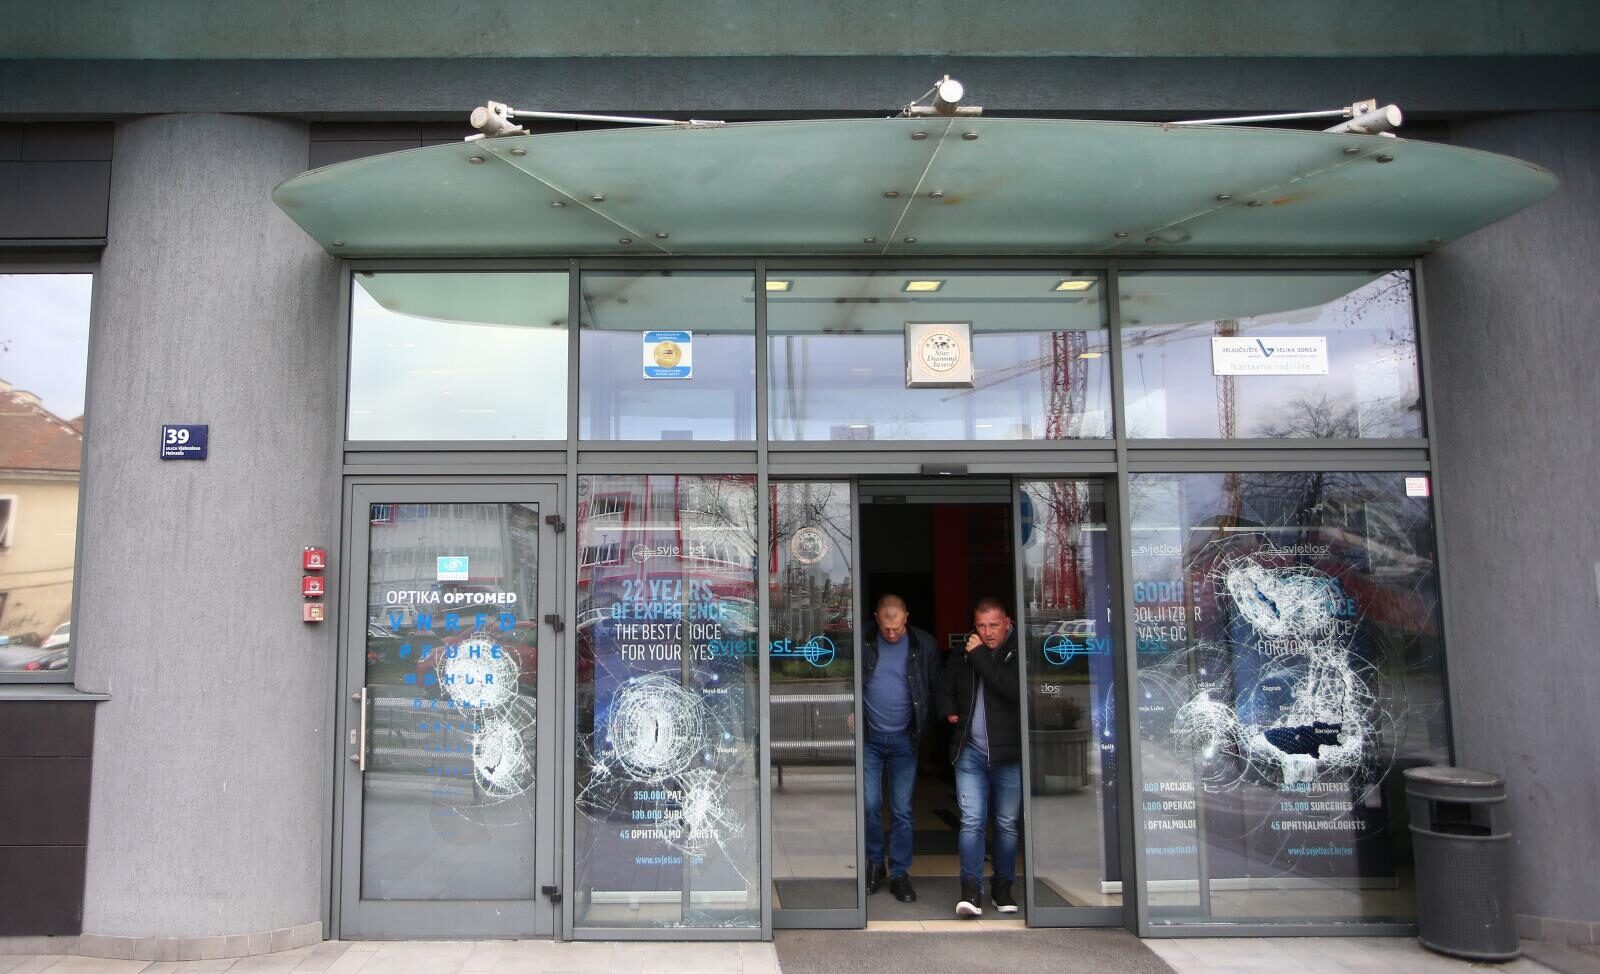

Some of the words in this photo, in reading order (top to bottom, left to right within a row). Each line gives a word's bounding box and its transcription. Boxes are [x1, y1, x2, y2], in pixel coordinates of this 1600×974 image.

[166, 429, 190, 444] 39
[656, 544, 707, 558] svjeost
[1283, 543, 1330, 554] svjetlost
[622, 579, 644, 601] 22
[648, 579, 713, 601] YEARS
[386, 590, 441, 604] OPTIKA
[443, 592, 517, 604] OPTOMED
[611, 602, 631, 619] OF
[634, 602, 728, 619] EXPERENCE
[1168, 607, 1202, 621] IZBR
[615, 623, 639, 640] THE
[642, 623, 672, 640] BEST
[1170, 622, 1187, 641] OČ
[621, 644, 645, 660] FOR
[648, 644, 682, 660] YOUR
[689, 644, 715, 660] YES
[1101, 743, 1114, 751] Split
[1312, 782, 1349, 792] PATIENTS
[633, 791, 666, 800] 350.000
[1162, 800, 1196, 810] OPERACI
[1280, 801, 1309, 811] 125.000
[631, 809, 662, 820] 130.000
[1271, 820, 1280, 830] 45
[619, 829, 630, 840] 45
